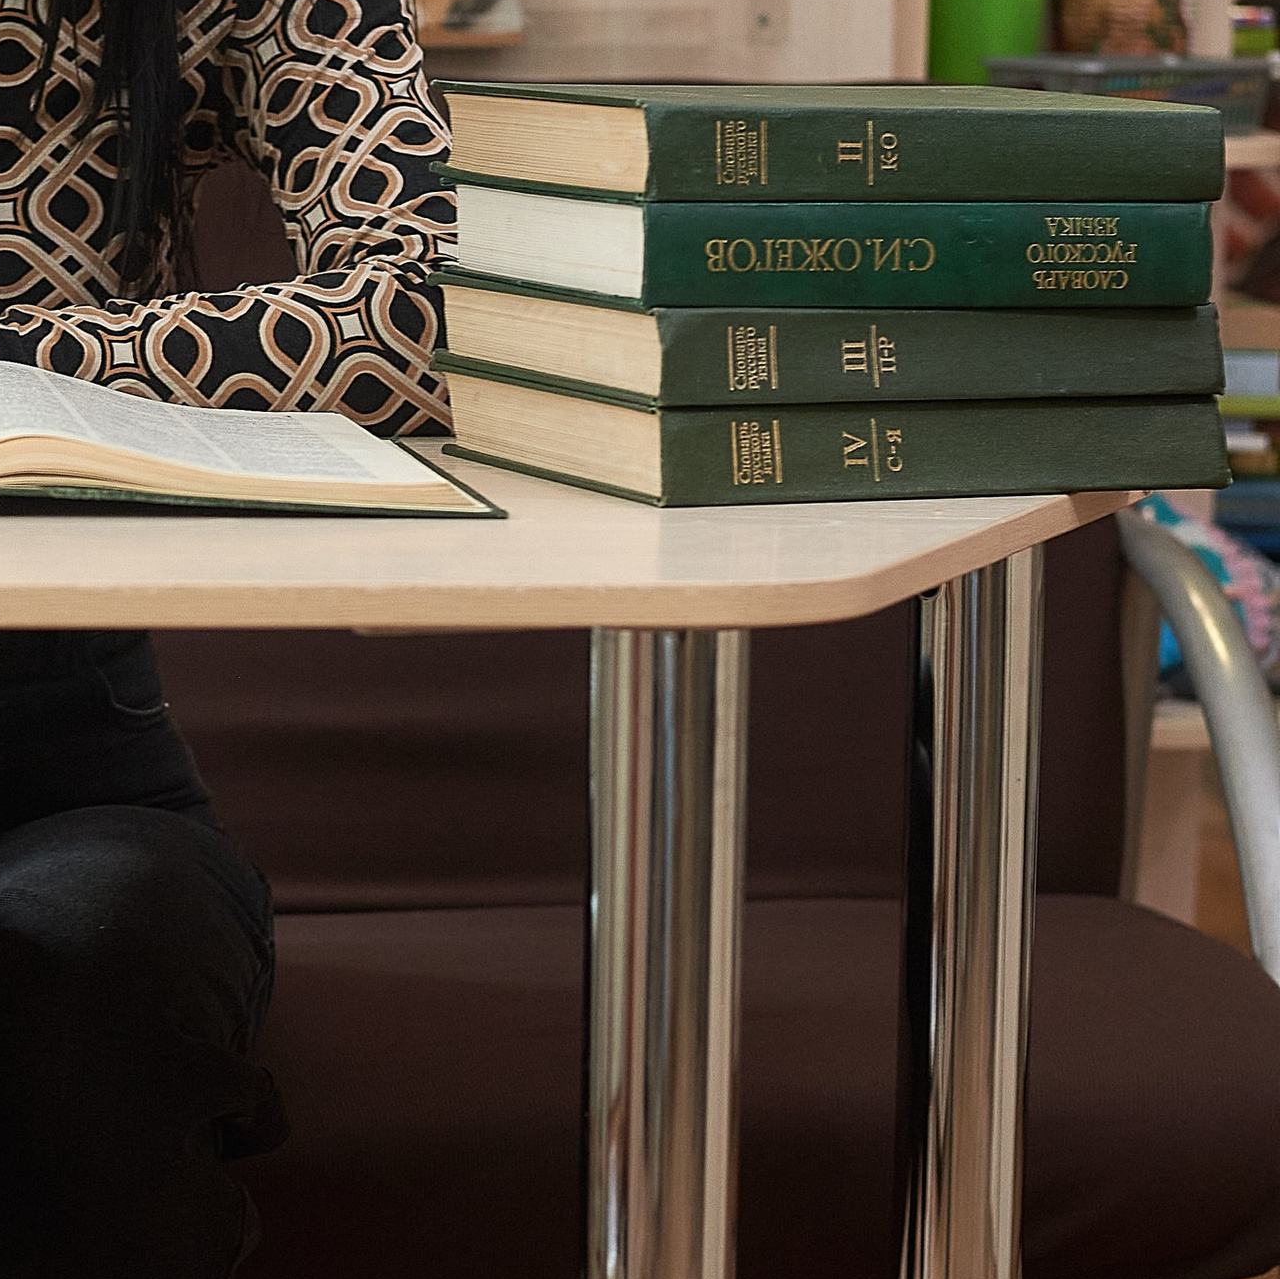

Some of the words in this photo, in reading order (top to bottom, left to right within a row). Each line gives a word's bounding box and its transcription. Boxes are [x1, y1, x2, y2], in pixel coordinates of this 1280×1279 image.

[723, 120, 737, 185] Словарь
[736, 121, 750, 186] русского
[748, 130, 758, 177] языка
[1044, 216, 1120, 238] ЯЗЫКА
[1026, 241, 1137, 264] РУССКОГО
[1033, 270, 1129, 291] СЛОВАРЬ
[734, 326, 748, 391] Словарь
[746, 326, 761, 391] русского
[757, 336, 769, 382] языка
[841, 339, 868, 374] III
[878, 335, 898, 374] П-Р
[738, 422, 752, 485] Словарь
[750, 421, 766, 485] русского
[761, 431, 774, 475] языка
[841, 431, 869, 469] IV
[885, 429, 904, 473] С-Я
